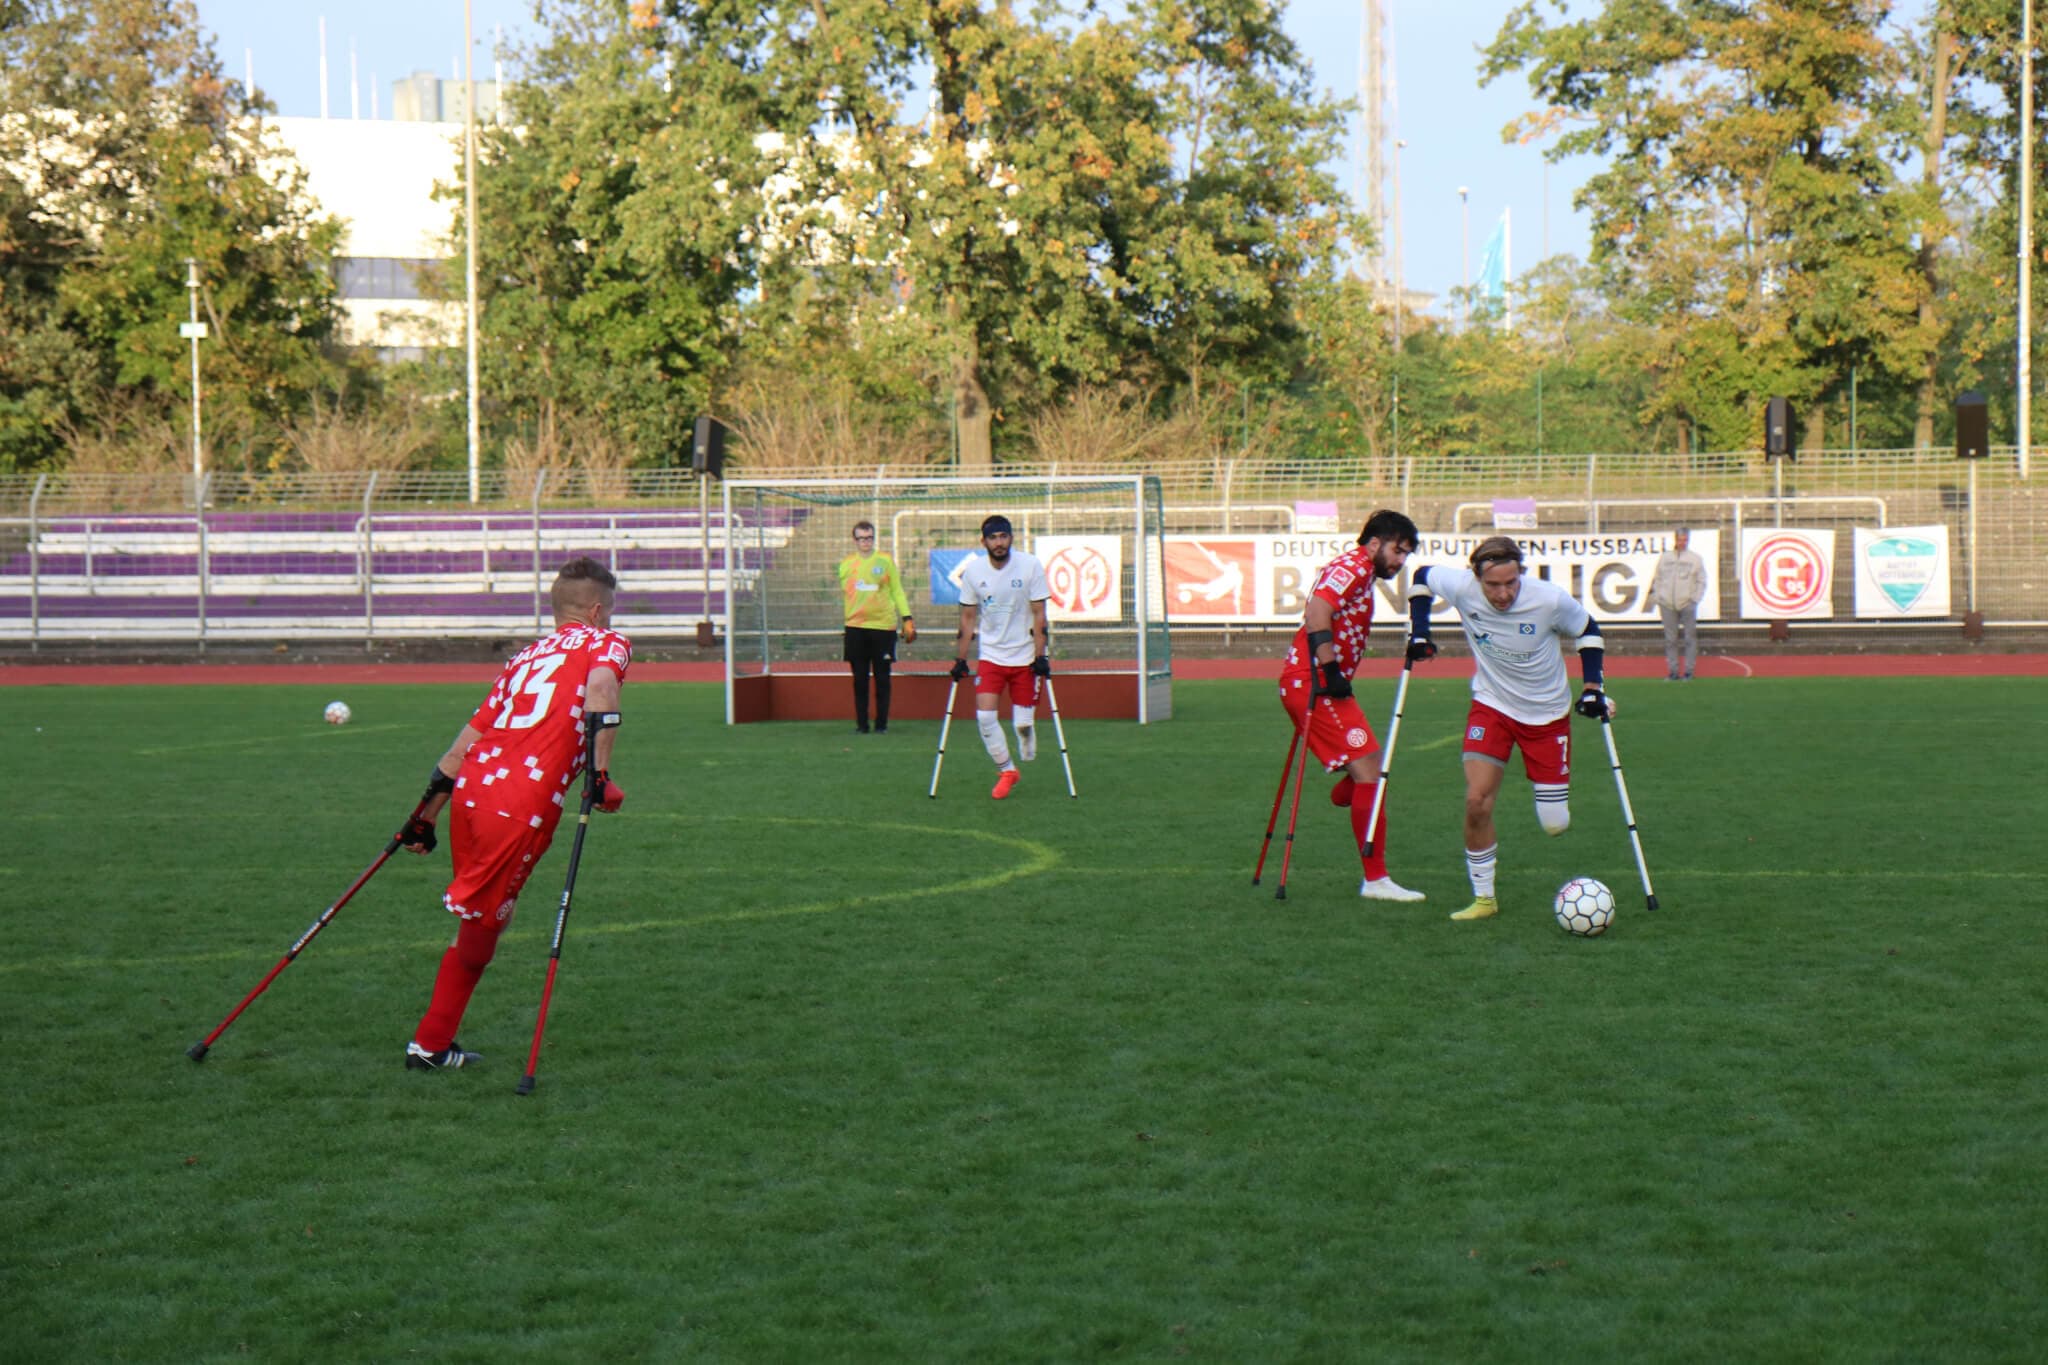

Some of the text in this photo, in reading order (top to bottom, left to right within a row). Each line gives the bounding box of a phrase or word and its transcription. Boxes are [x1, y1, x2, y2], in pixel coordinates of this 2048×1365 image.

[1273, 541, 1354, 556] DEUTSC
[493, 653, 568, 729] 13
[1557, 735, 1569, 762] 7
